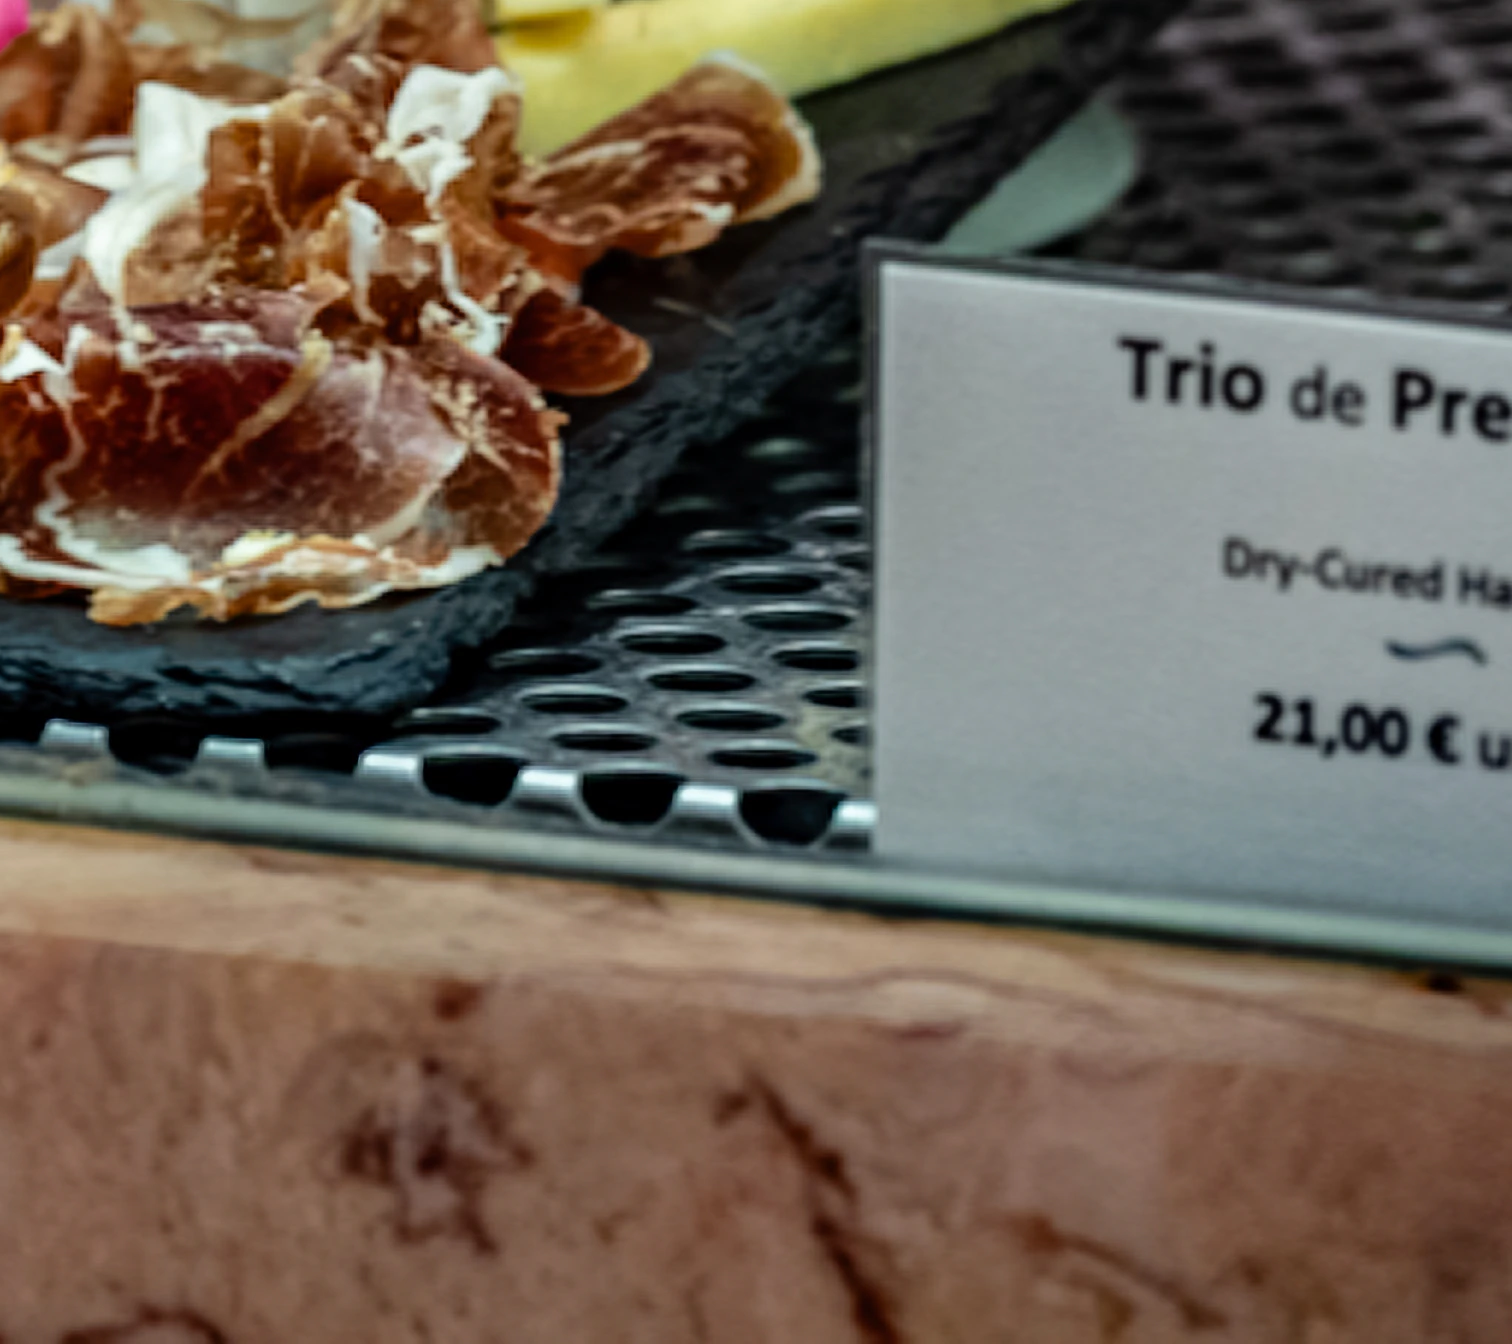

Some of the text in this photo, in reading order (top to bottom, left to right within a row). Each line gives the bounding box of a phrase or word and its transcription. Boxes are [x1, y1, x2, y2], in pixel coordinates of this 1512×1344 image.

[1117, 335, 1266, 413] Trio
[1289, 366, 1366, 427] de
[1222, 535, 1446, 603] Dry-Cured
[1253, 692, 1411, 759] 21,00
[1426, 714, 1460, 765] €
